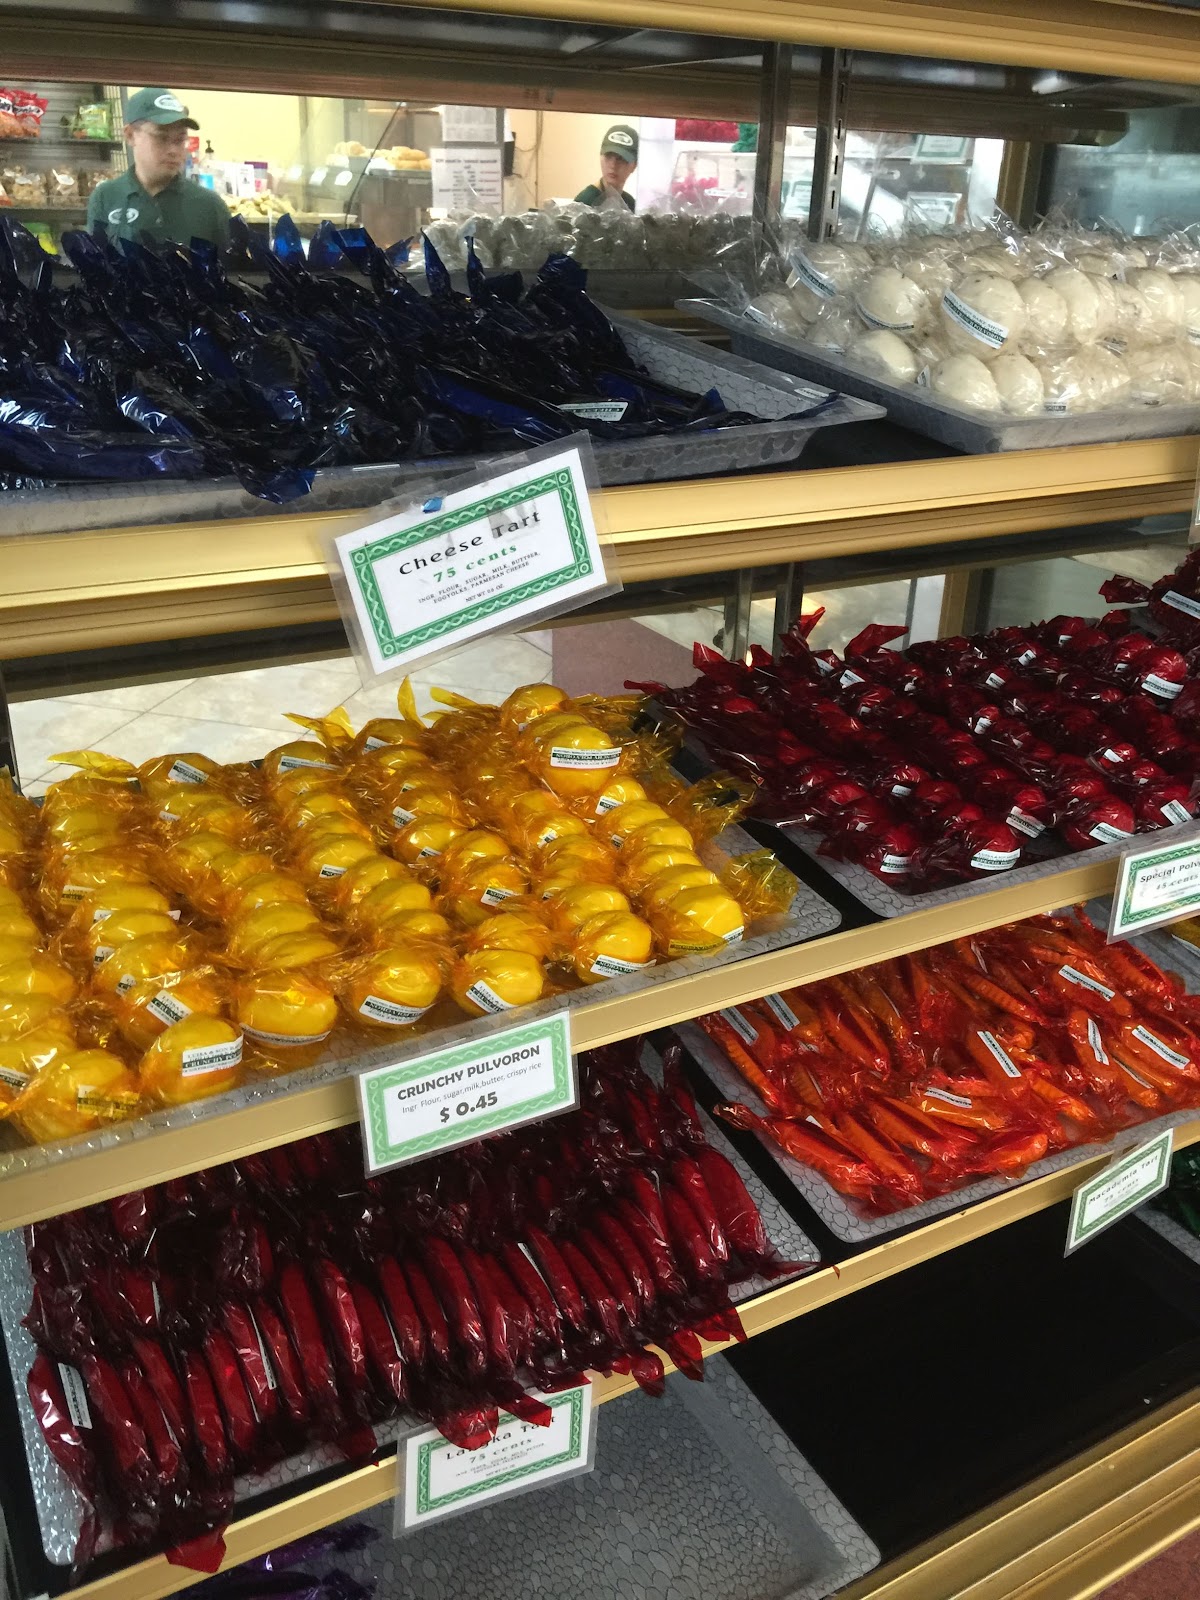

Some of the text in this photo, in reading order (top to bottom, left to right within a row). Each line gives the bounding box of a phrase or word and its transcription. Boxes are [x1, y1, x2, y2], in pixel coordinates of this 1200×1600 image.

[399, 511, 541, 575] Cheese Tart
[433, 545, 517, 583] 75 cents
[471, 571, 505, 588] PARMESAN
[506, 561, 530, 574] CHEESE
[1140, 867, 1176, 883] Special
[1169, 873, 1199, 887] cents
[397, 1044, 541, 1100] CRUNCHY PULVORON
[420, 1097, 442, 1108] Flour,
[507, 1066, 528, 1081] crispy
[529, 1061, 542, 1071] rice
[439, 1091, 498, 1123] $ 0.45
[1142, 1155, 1158, 1169] Tart
[521, 1416, 555, 1433] Tat
[469, 1453, 486, 1463] 75
[493, 1438, 531, 1456] cents
